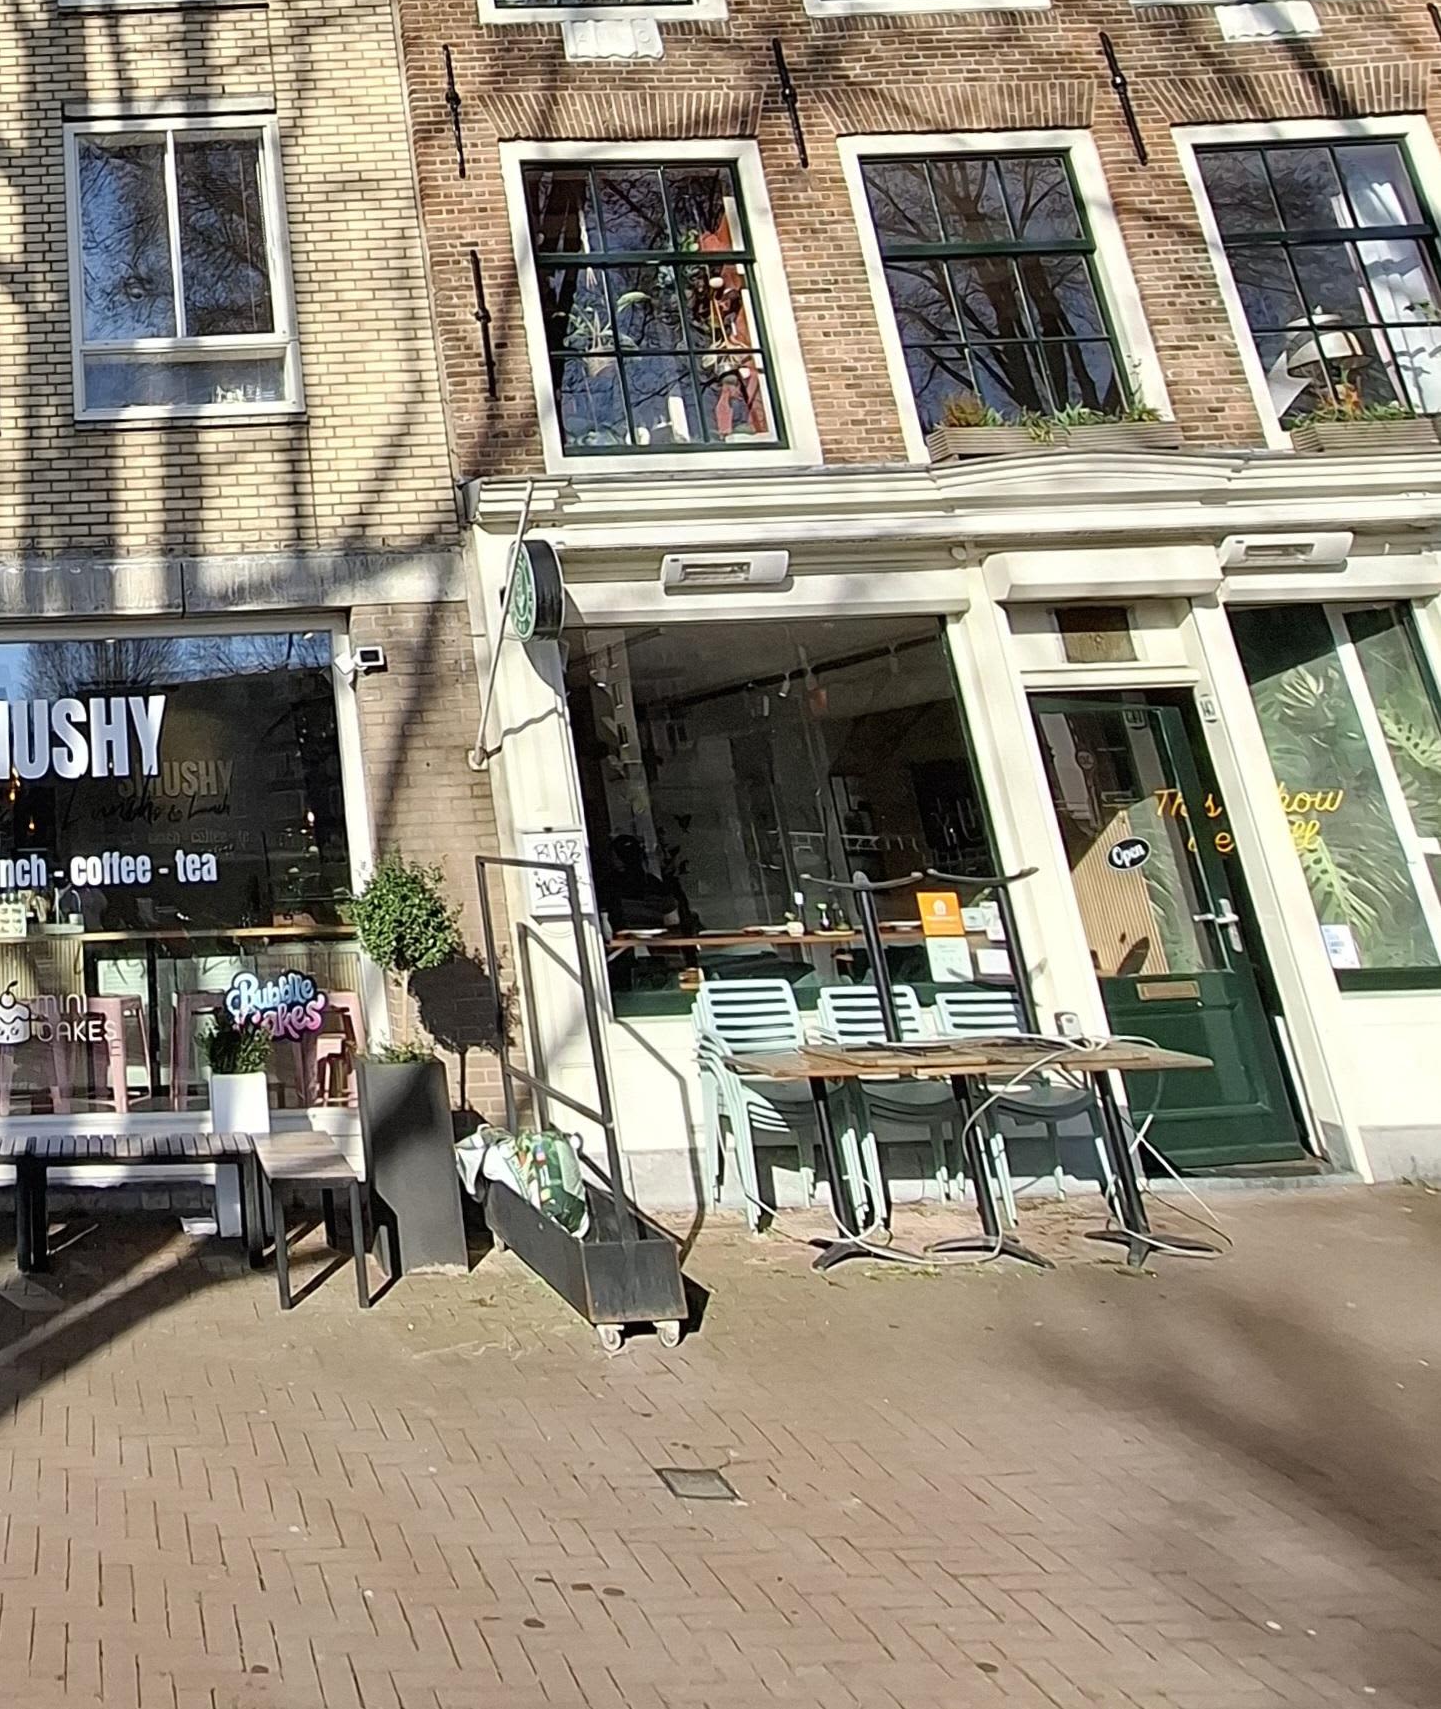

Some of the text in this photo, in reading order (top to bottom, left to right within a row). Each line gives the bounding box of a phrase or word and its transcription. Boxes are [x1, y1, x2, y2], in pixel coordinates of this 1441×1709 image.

[70, 850, 152, 887] coffee
[175, 849, 218, 884] tea
[1111, 843, 1147, 868] Open
[37, 1019, 119, 1042] CAKES
